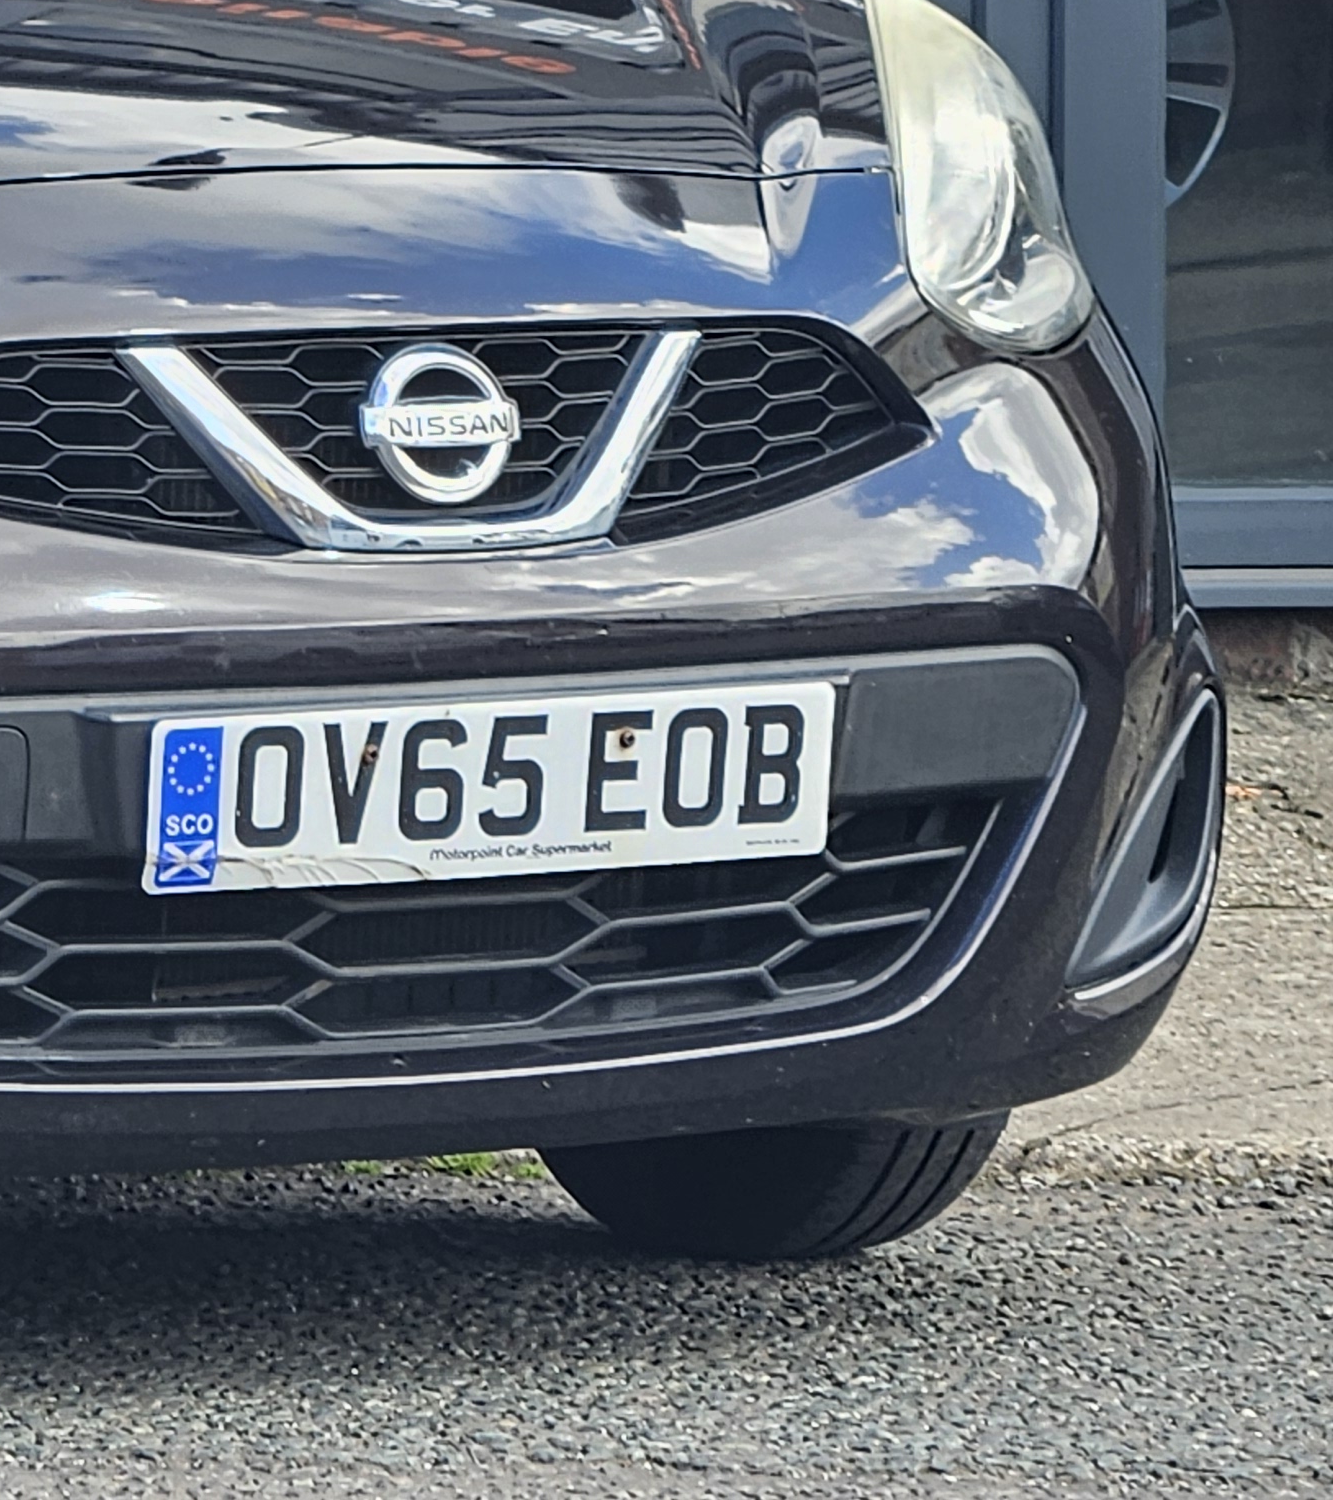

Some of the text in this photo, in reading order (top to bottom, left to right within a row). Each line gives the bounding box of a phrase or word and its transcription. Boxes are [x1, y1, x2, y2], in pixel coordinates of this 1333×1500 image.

[388, 412, 509, 438] NISSAN
[234, 703, 805, 849] OV65 EOB
[165, 813, 213, 837] SCO
[430, 840, 612, 861] Motorpoint Car Supermarket
